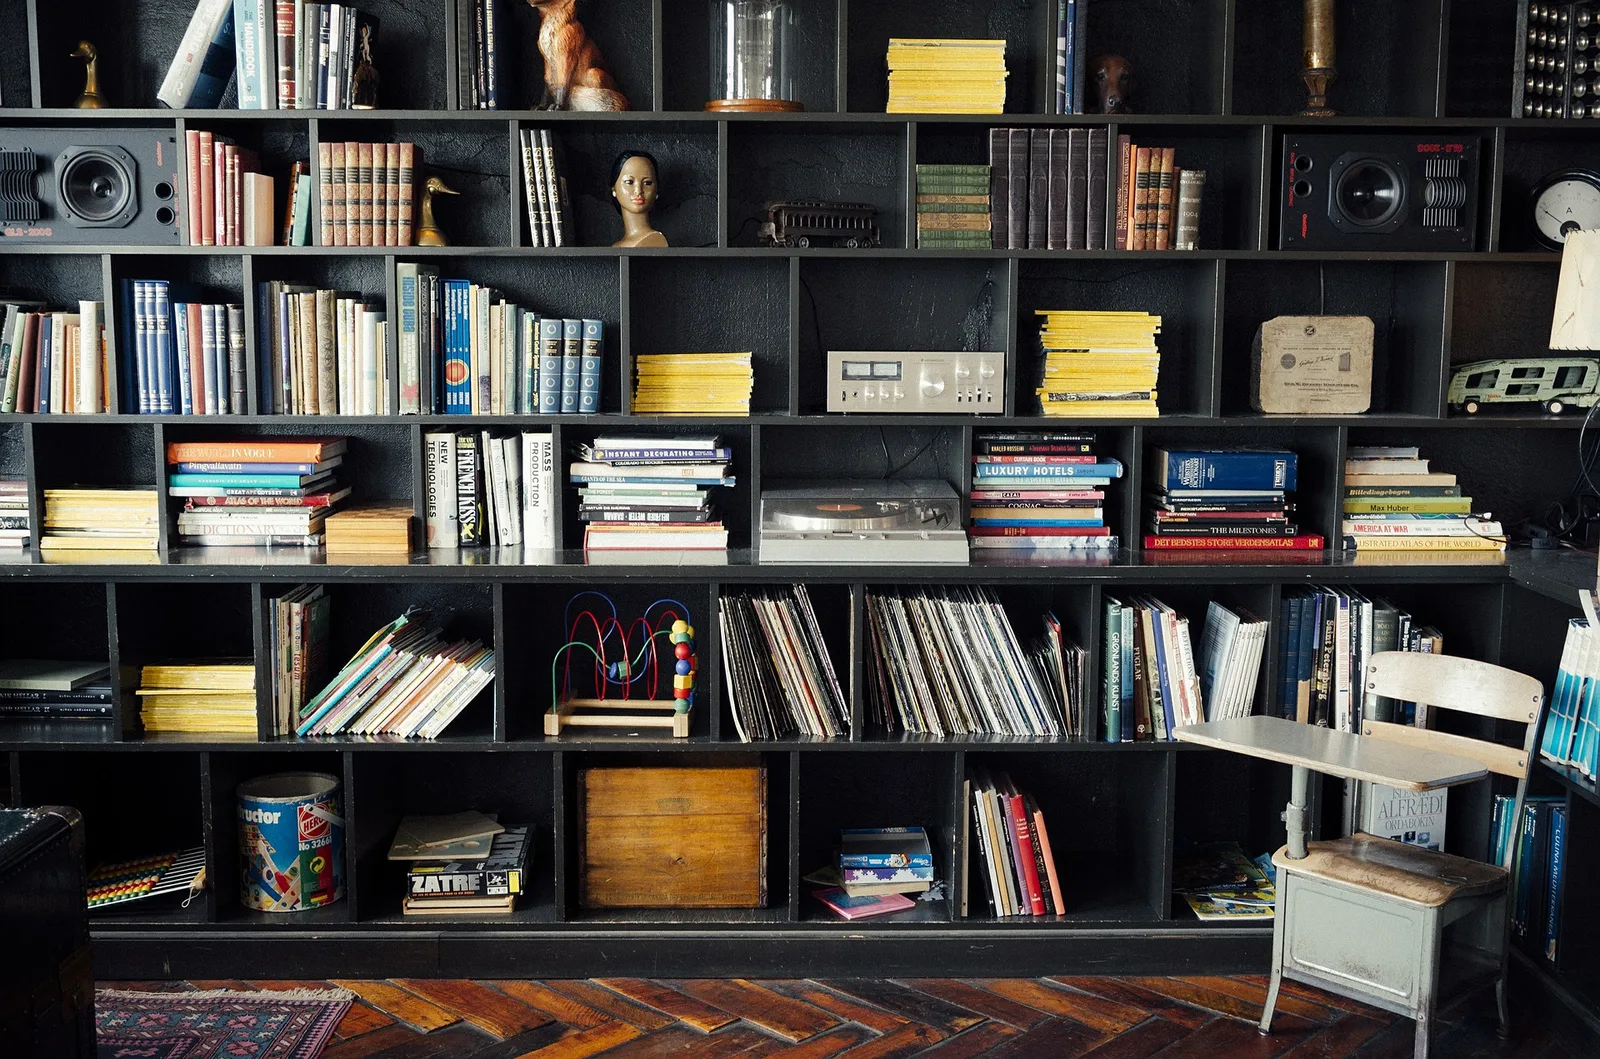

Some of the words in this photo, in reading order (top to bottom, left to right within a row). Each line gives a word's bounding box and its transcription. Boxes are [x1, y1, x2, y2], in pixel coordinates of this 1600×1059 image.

[244, 22, 256, 78] HANDBOOK
[231, 449, 241, 458] IN
[243, 449, 275, 458] VOGUE
[440, 441, 448, 464] NEW
[544, 441, 552, 472] MASS
[604, 449, 641, 459] INSTANT
[644, 449, 695, 458] DECORATING
[428, 441, 437, 519] TECHNOLOGIES
[457, 450, 476, 494] FRENCH
[531, 441, 540, 508] PRODUCTION
[580, 475, 598, 483] GIANTS
[985, 467, 1029, 476] LUXURY
[1033, 466, 1075, 476] HOTELS
[225, 496, 247, 505] ATLAS
[248, 496, 260, 505] OF
[261, 497, 277, 505] THE
[277, 496, 303, 505] WORLD
[458, 496, 476, 523] KISS
[1370, 504, 1385, 512] Max
[1387, 503, 1409, 512] Huber
[203, 524, 277, 535] DICTIONARY
[1210, 527, 1228, 535] THE
[1229, 527, 1277, 535] MILESTONES
[1353, 524, 1383, 533] AMERICA
[1384, 525, 1392, 533] AT
[1393, 525, 1410, 533] WAR
[1154, 538, 1170, 547] DET
[1171, 538, 1206, 547] BEDSTES
[1207, 538, 1234, 547] STORE
[1235, 538, 1294, 547] VERDENSATLAS
[1359, 540, 1397, 548] USTRATED
[1399, 540, 1426, 548] ATLAS
[1325, 620, 1335, 645] Saint
[1111, 632, 1120, 683] GRØNLANDS
[1133, 647, 1142, 681] FUGLAR
[1182, 630, 1194, 679] REFLECTIONS
[293, 653, 301, 681] lesum
[1318, 646, 1333, 701] Petersburg
[1111, 685, 1120, 713] KUNST
[299, 842, 310, 852] No
[1553, 829, 1561, 864] CULINA
[1036, 855, 1046, 874] SKIP
[411, 874, 481, 894] ZATRE
[1547, 865, 1558, 936] MEDITERRANEA
